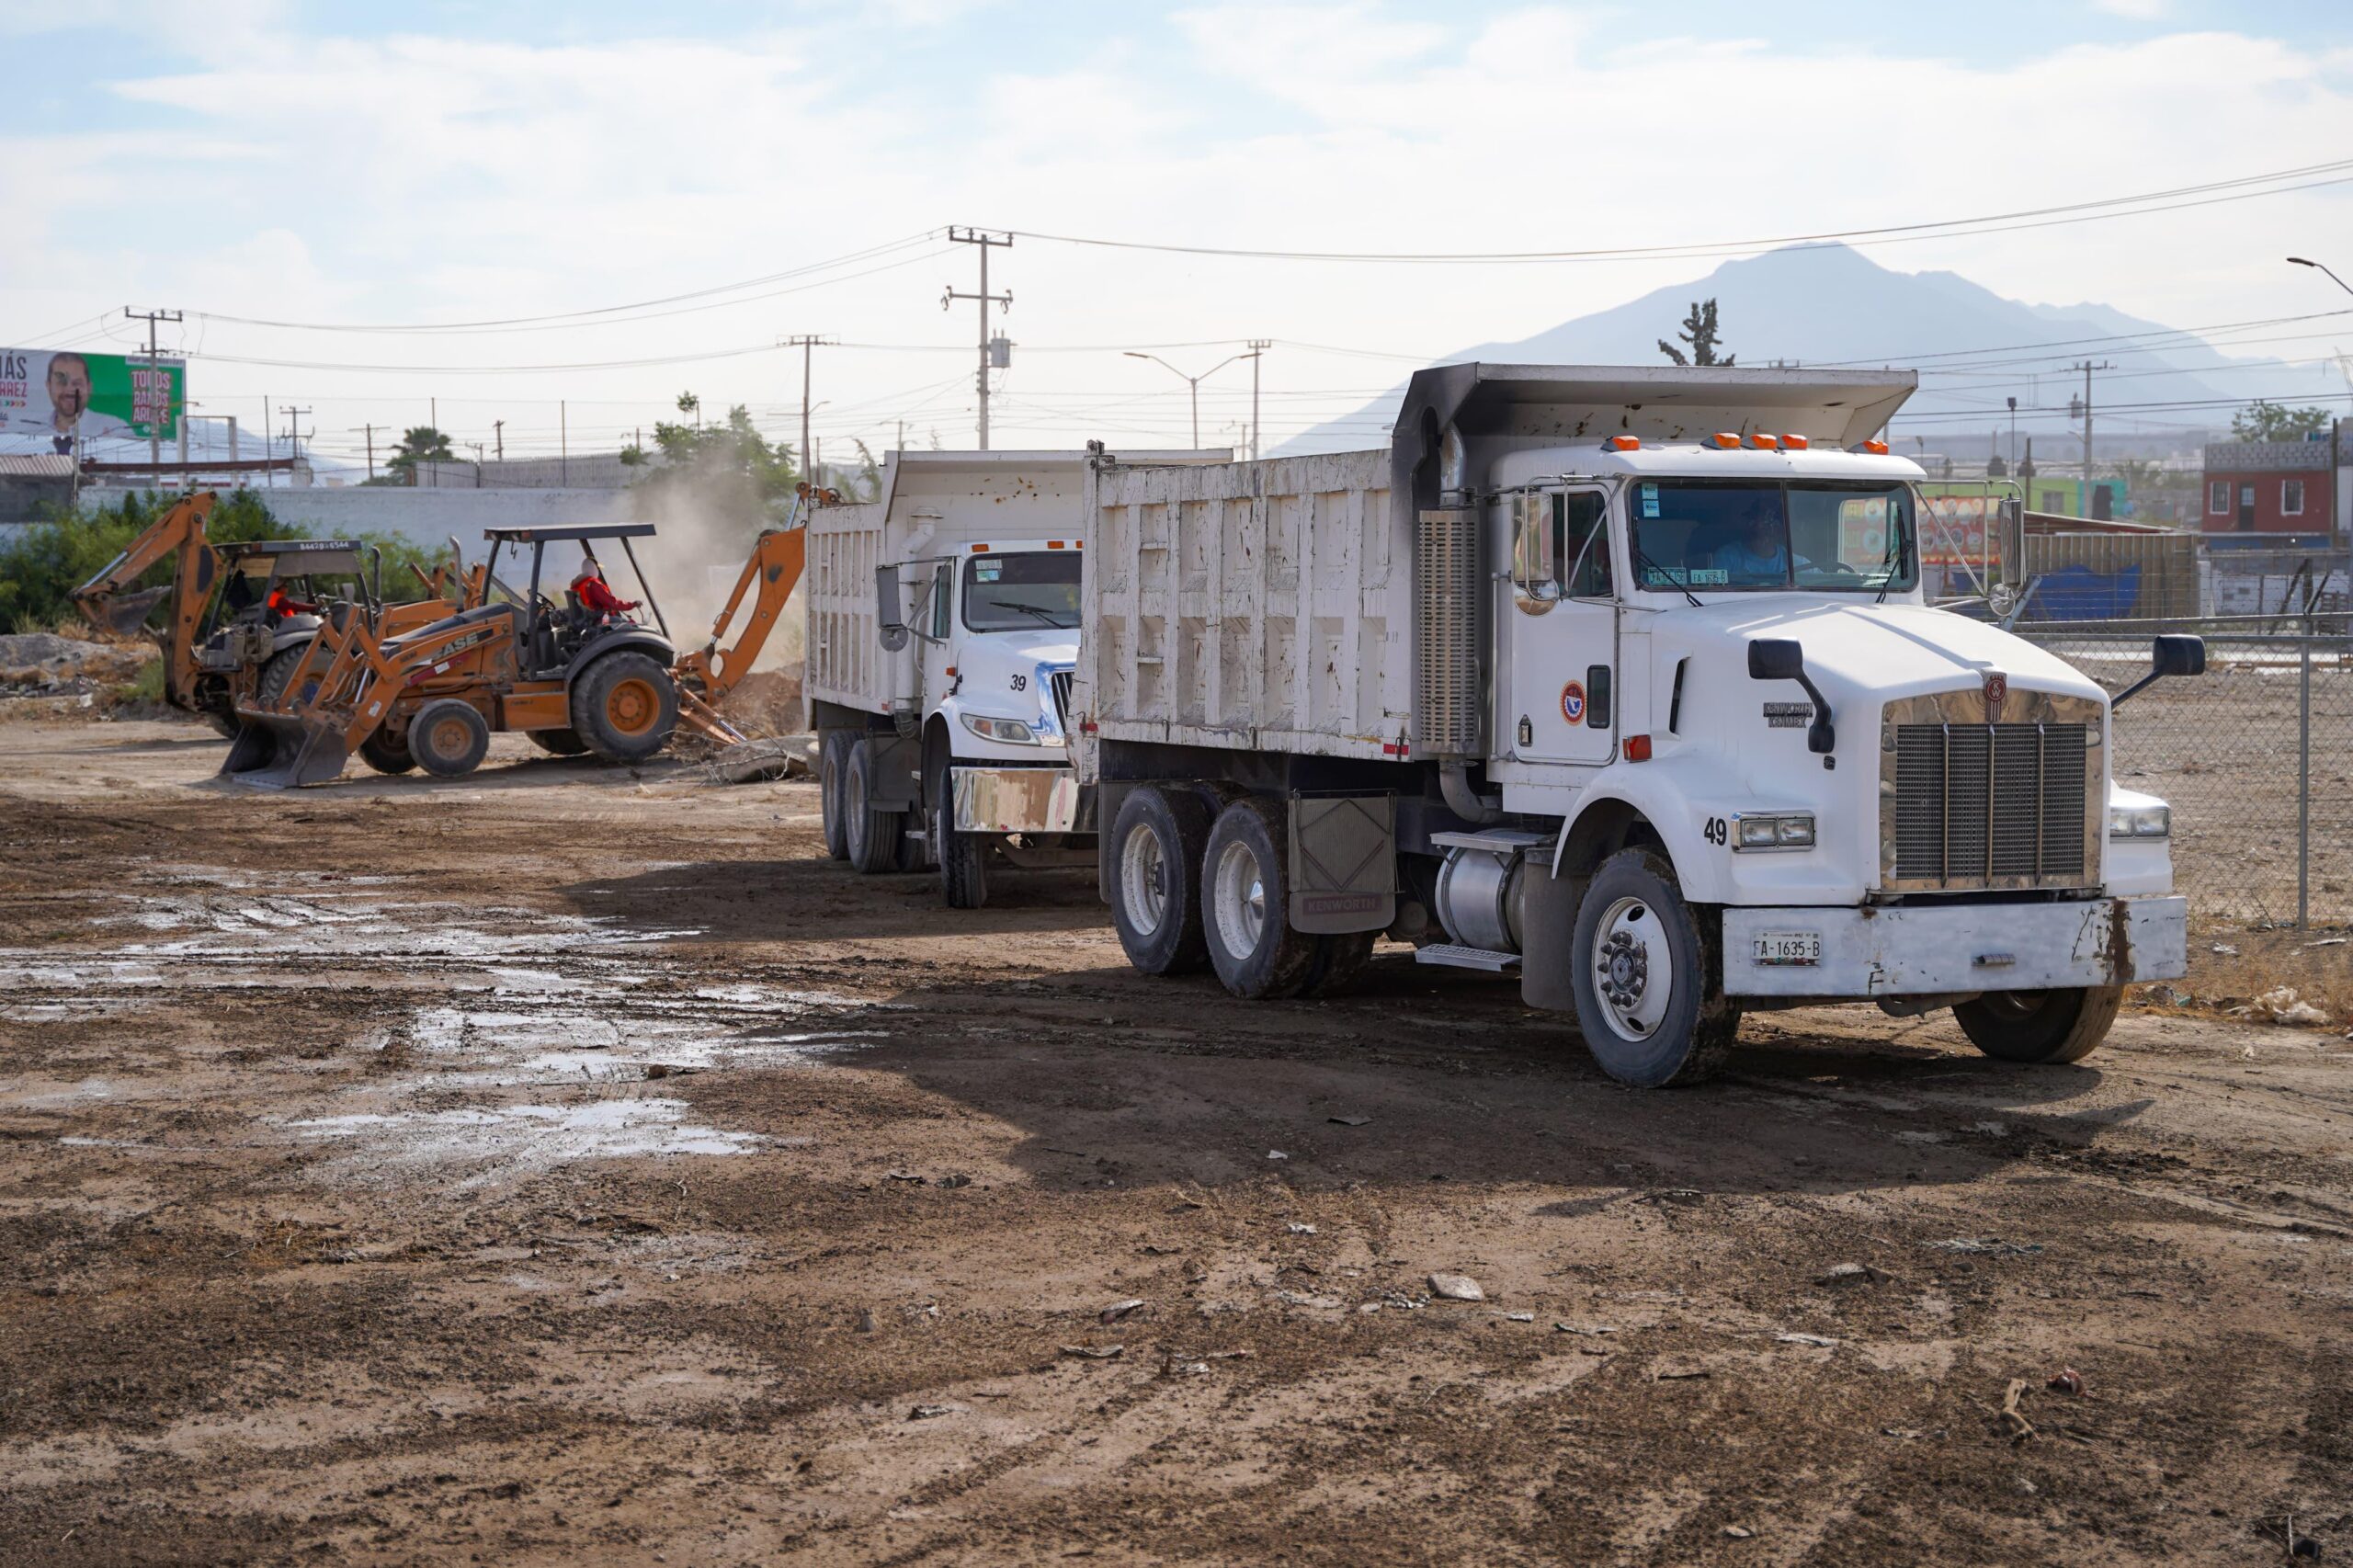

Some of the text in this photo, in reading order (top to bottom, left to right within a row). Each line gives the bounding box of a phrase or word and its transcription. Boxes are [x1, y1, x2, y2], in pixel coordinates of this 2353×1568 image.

[0, 351, 27, 380] ÁS
[133, 407, 169, 424] ARIE
[1010, 674, 1027, 692] 39
[1763, 702, 1813, 715] KENWORTH
[1768, 717, 1806, 728] KENMEX
[1704, 816, 1727, 846] 49
[1308, 898, 1376, 913] KENWORTH
[1753, 940, 1820, 957] FA-1635-B
